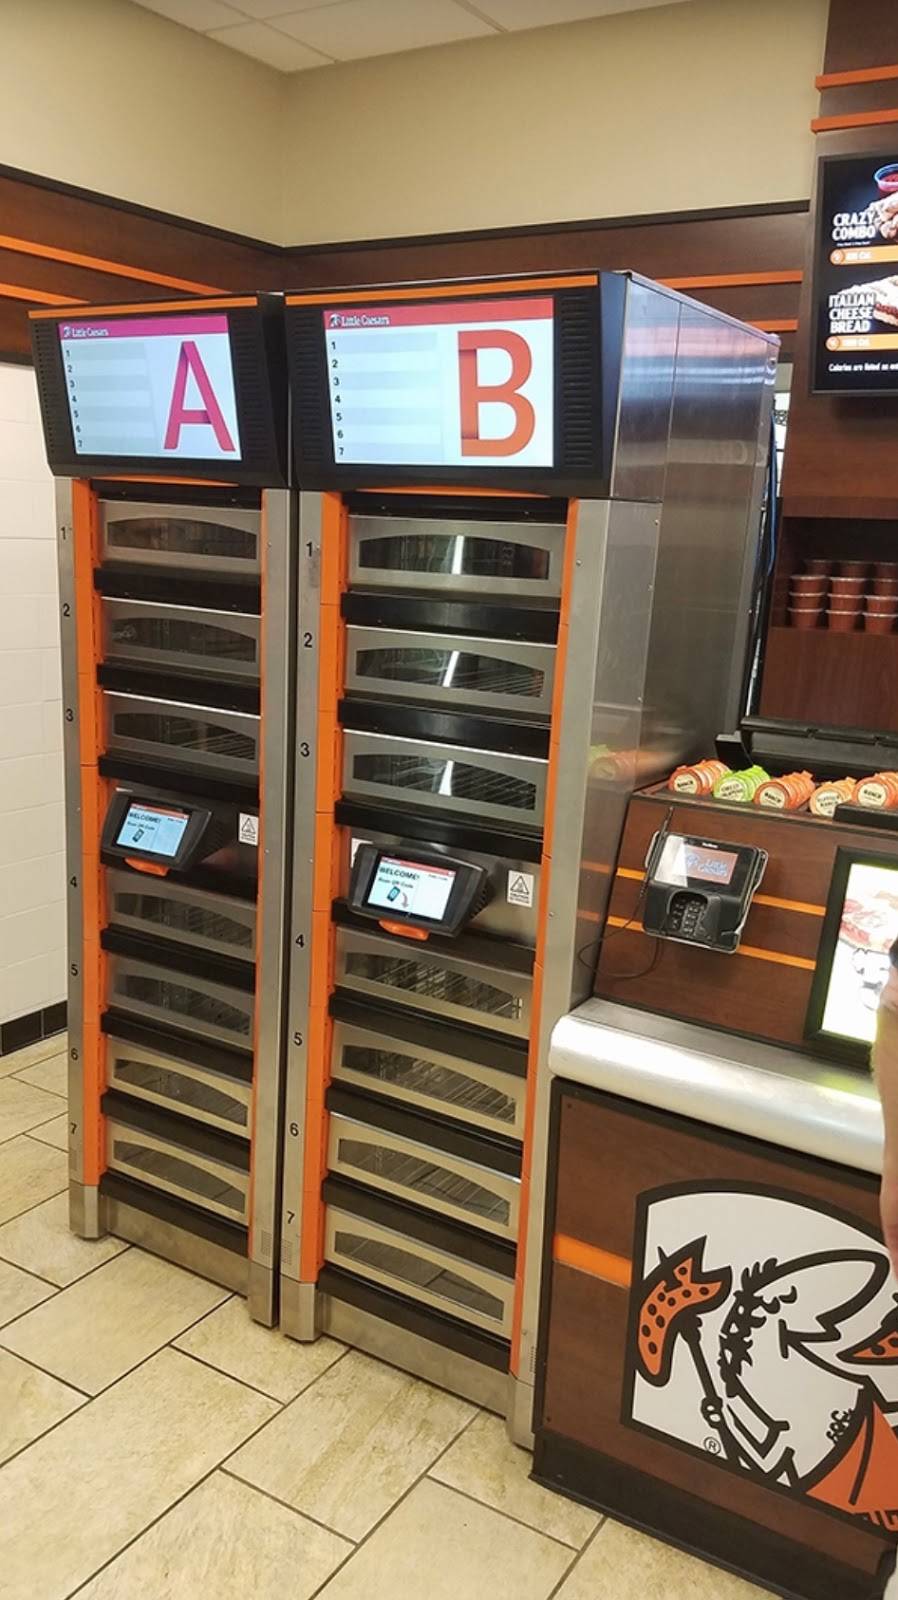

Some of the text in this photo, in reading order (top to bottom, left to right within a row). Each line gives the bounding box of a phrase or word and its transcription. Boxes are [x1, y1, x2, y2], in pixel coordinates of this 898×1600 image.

[833, 212, 875, 226] CRAZY
[832, 226, 876, 241] COMBO
[829, 294, 875, 307] ITALIAN
[829, 307, 873, 320] CHEESE
[830, 320, 870, 333] BREAD
[164, 341, 236, 451] A
[457, 329, 536, 457] B
[60, 526, 67, 540] 1
[306, 541, 313, 558] 1
[62, 602, 71, 617] 2
[303, 632, 313, 648] 2
[65, 708, 74, 722] 3
[300, 742, 310, 757] 3
[69, 875, 78, 888] 4
[295, 934, 305, 949] 4
[70, 963, 79, 977] 5
[293, 1031, 303, 1047] 5
[70, 1047, 79, 1061] 6
[70, 1122, 78, 1135] 7
[289, 1122, 299, 1137] 6
[286, 1210, 295, 1225] 7
